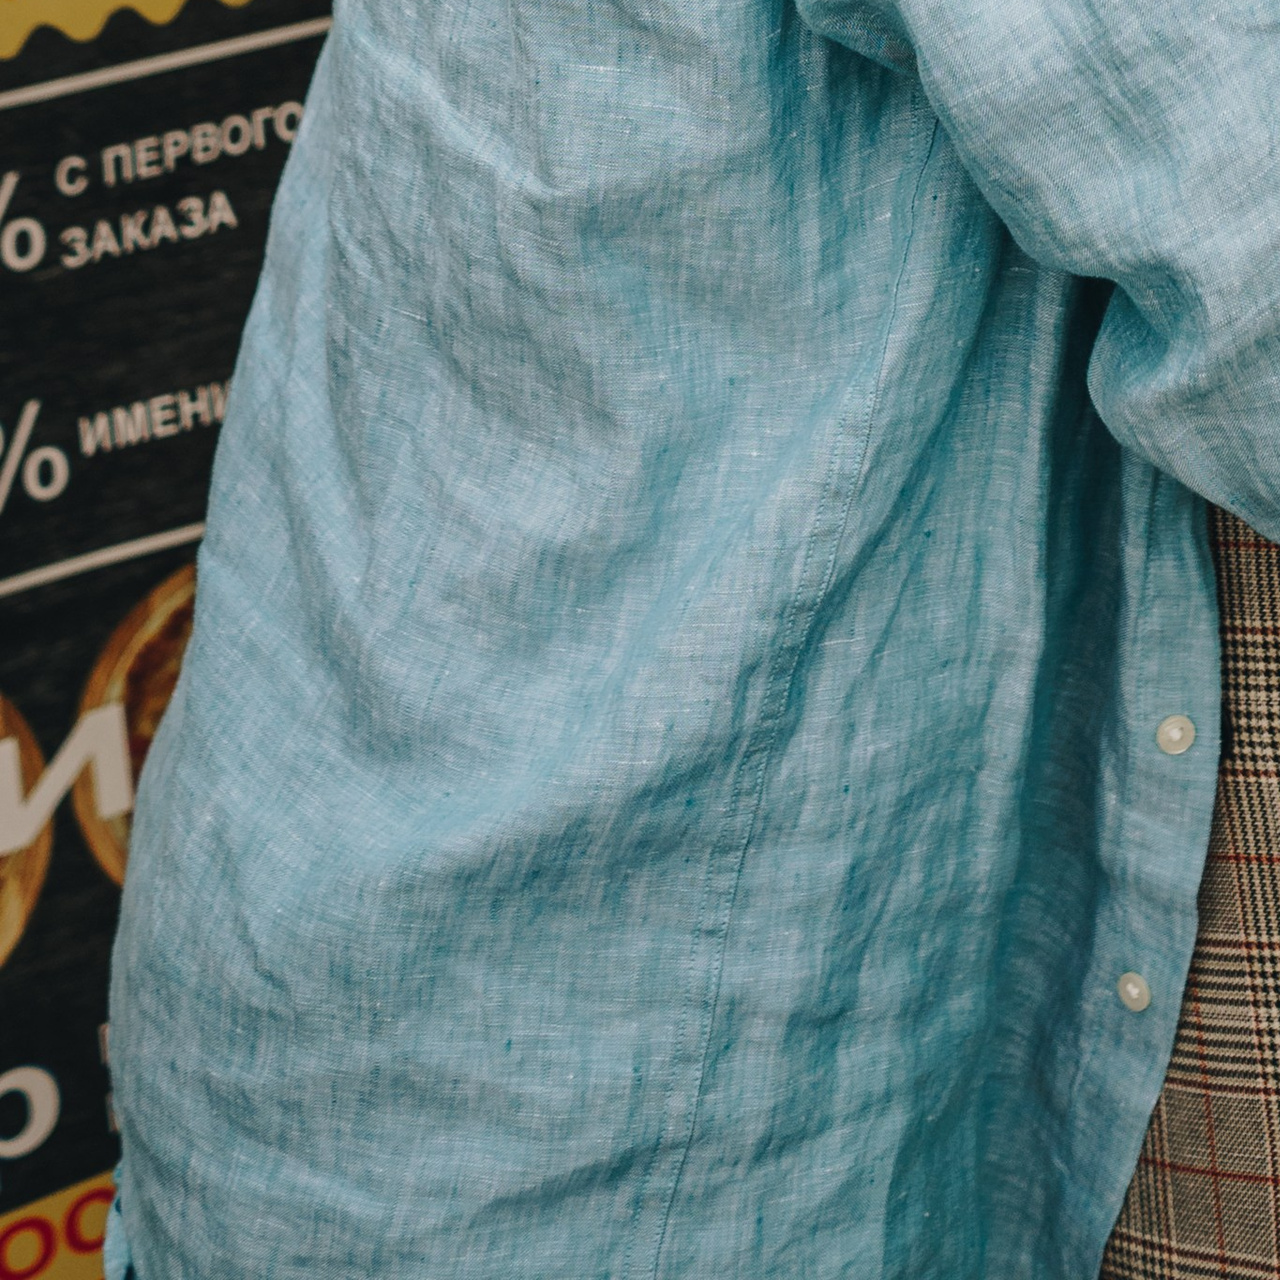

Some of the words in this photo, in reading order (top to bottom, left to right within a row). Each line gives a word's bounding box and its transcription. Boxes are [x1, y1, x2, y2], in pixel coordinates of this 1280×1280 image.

[55, 155, 89, 197] С
[102, 100, 304, 188] ПЕРВОГО
[58, 190, 238, 270] ЗАКАЗА
